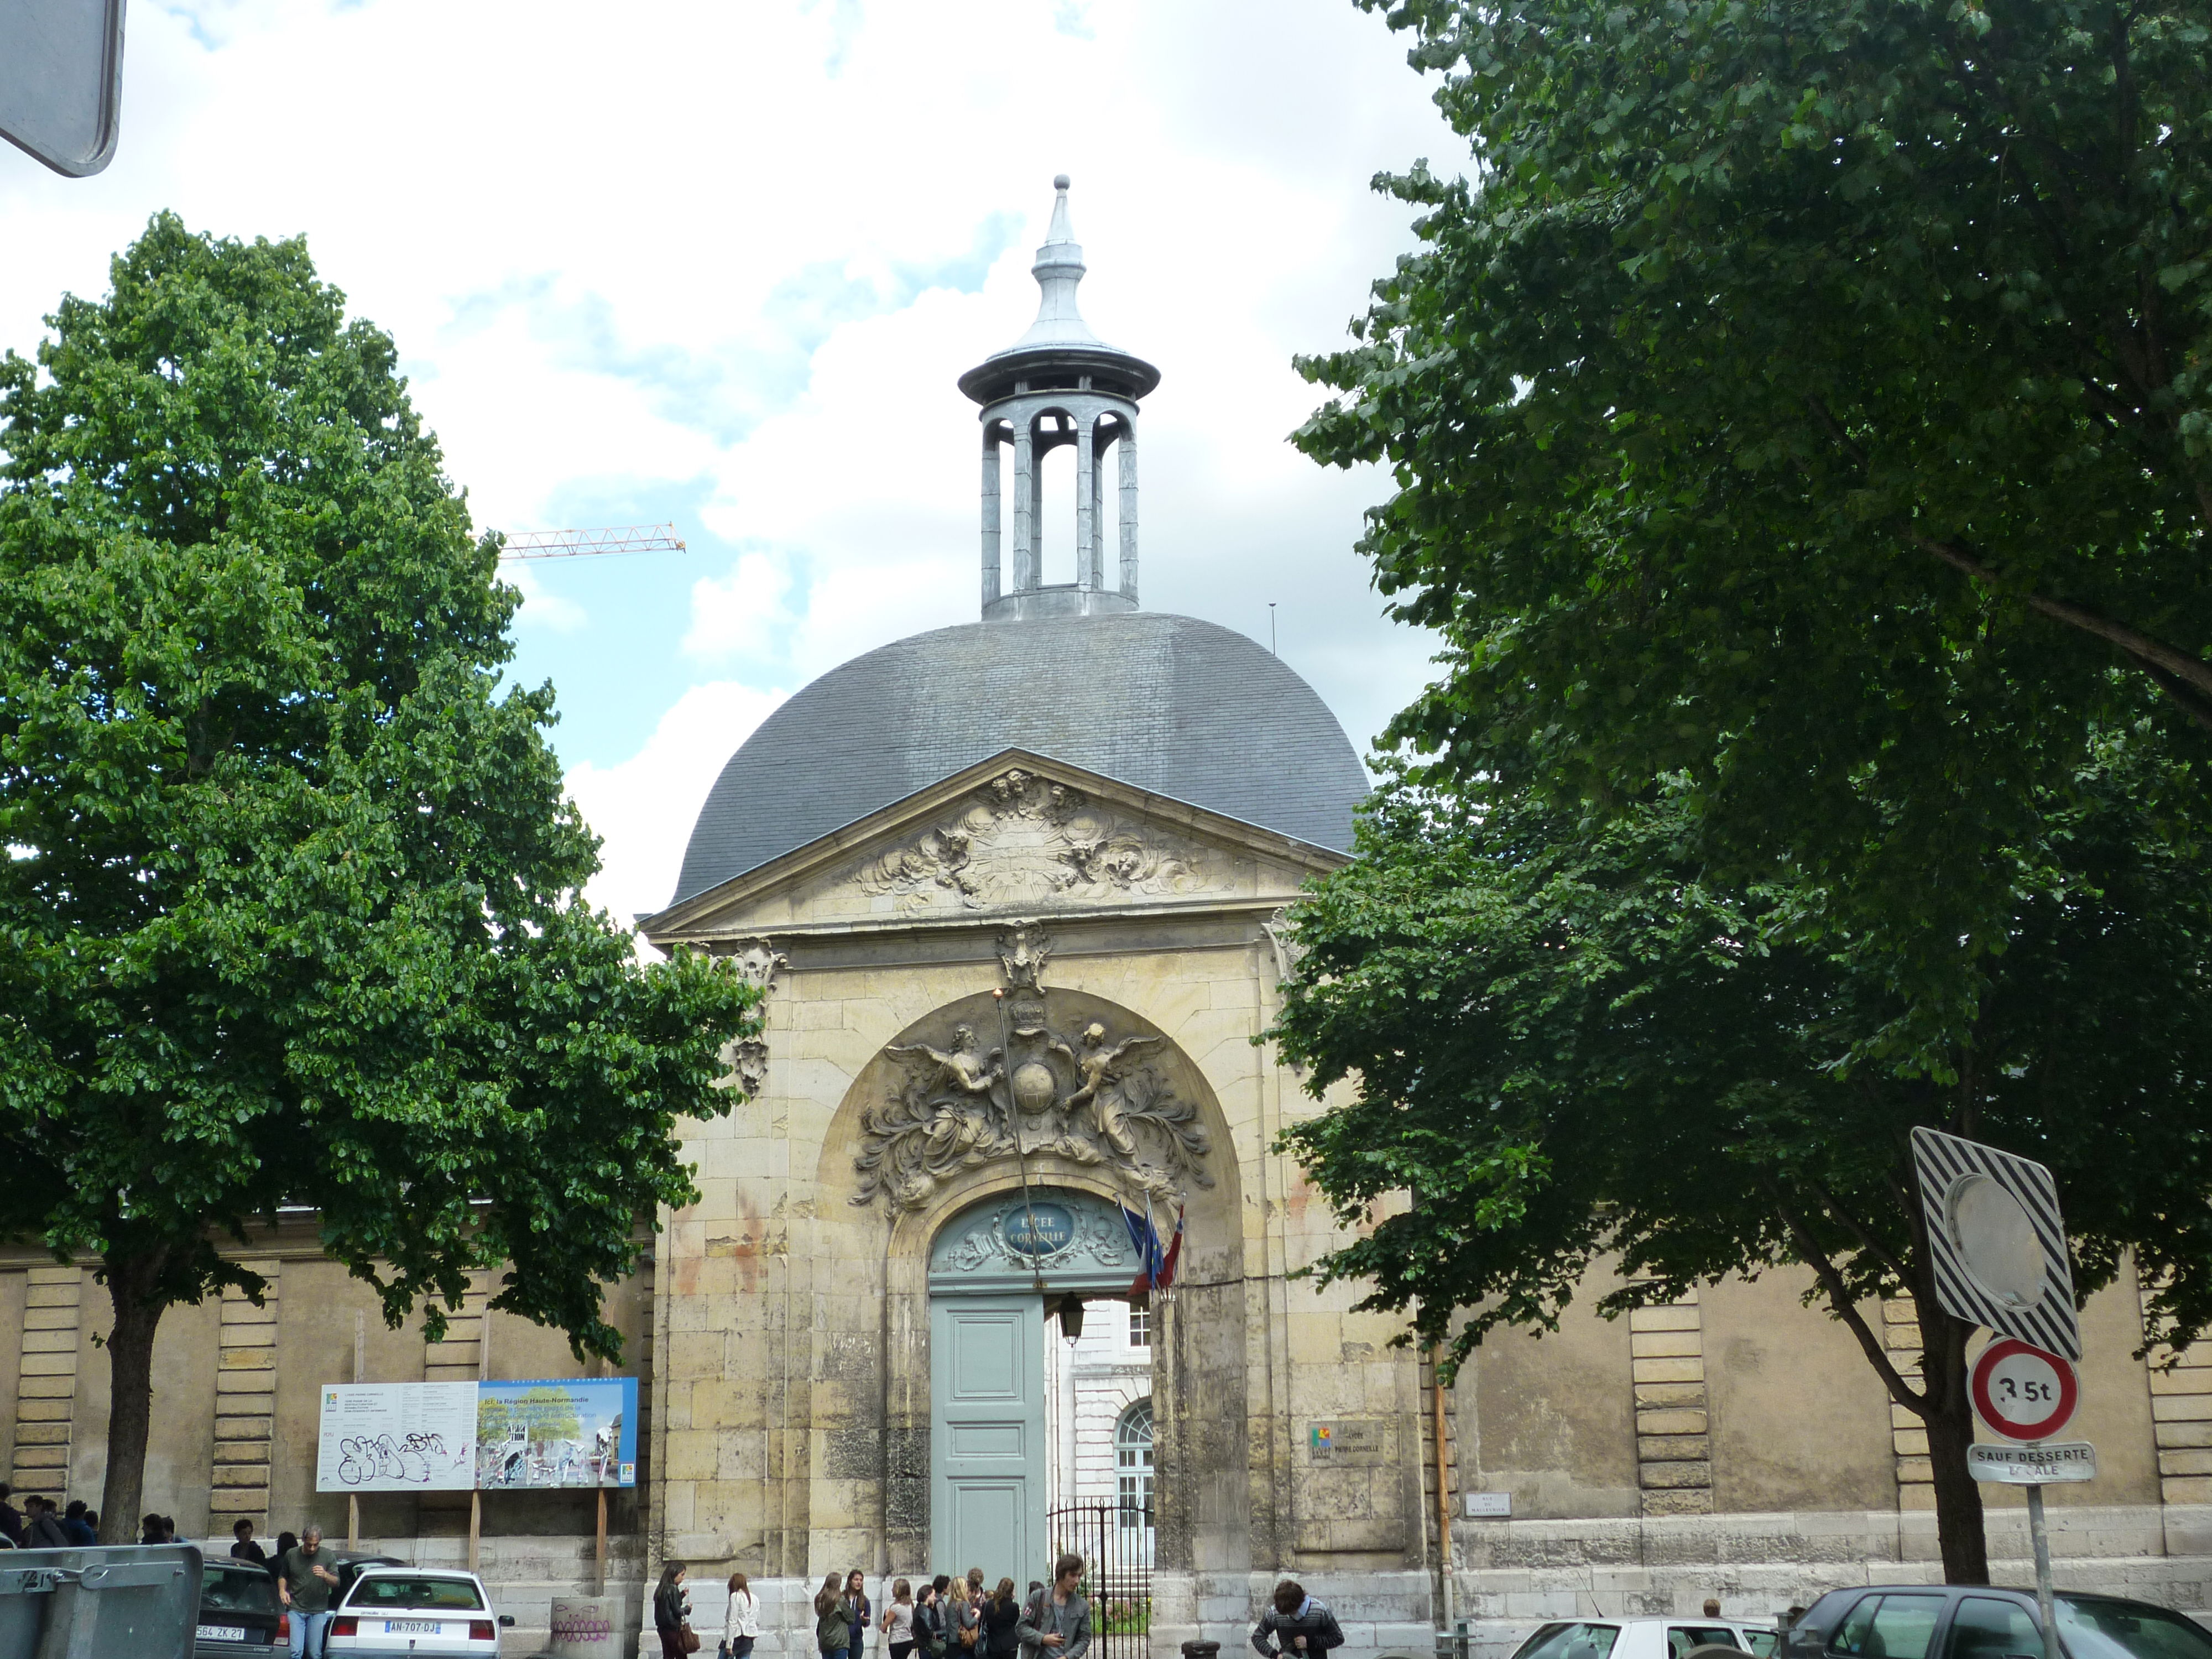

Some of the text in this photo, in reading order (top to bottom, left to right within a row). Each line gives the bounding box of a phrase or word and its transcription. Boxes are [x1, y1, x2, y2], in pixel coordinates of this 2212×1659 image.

[1021, 1217, 1055, 1228] LCEE
[1353, 1444, 1379, 1453] CORNEILLE
[1977, 1448, 2089, 1463] SAUF DESSERTE
[217, 1627, 228, 1637] ZK
[231, 1629, 242, 1638] 27
[391, 1622, 435, 1632] AN-707-DJ
